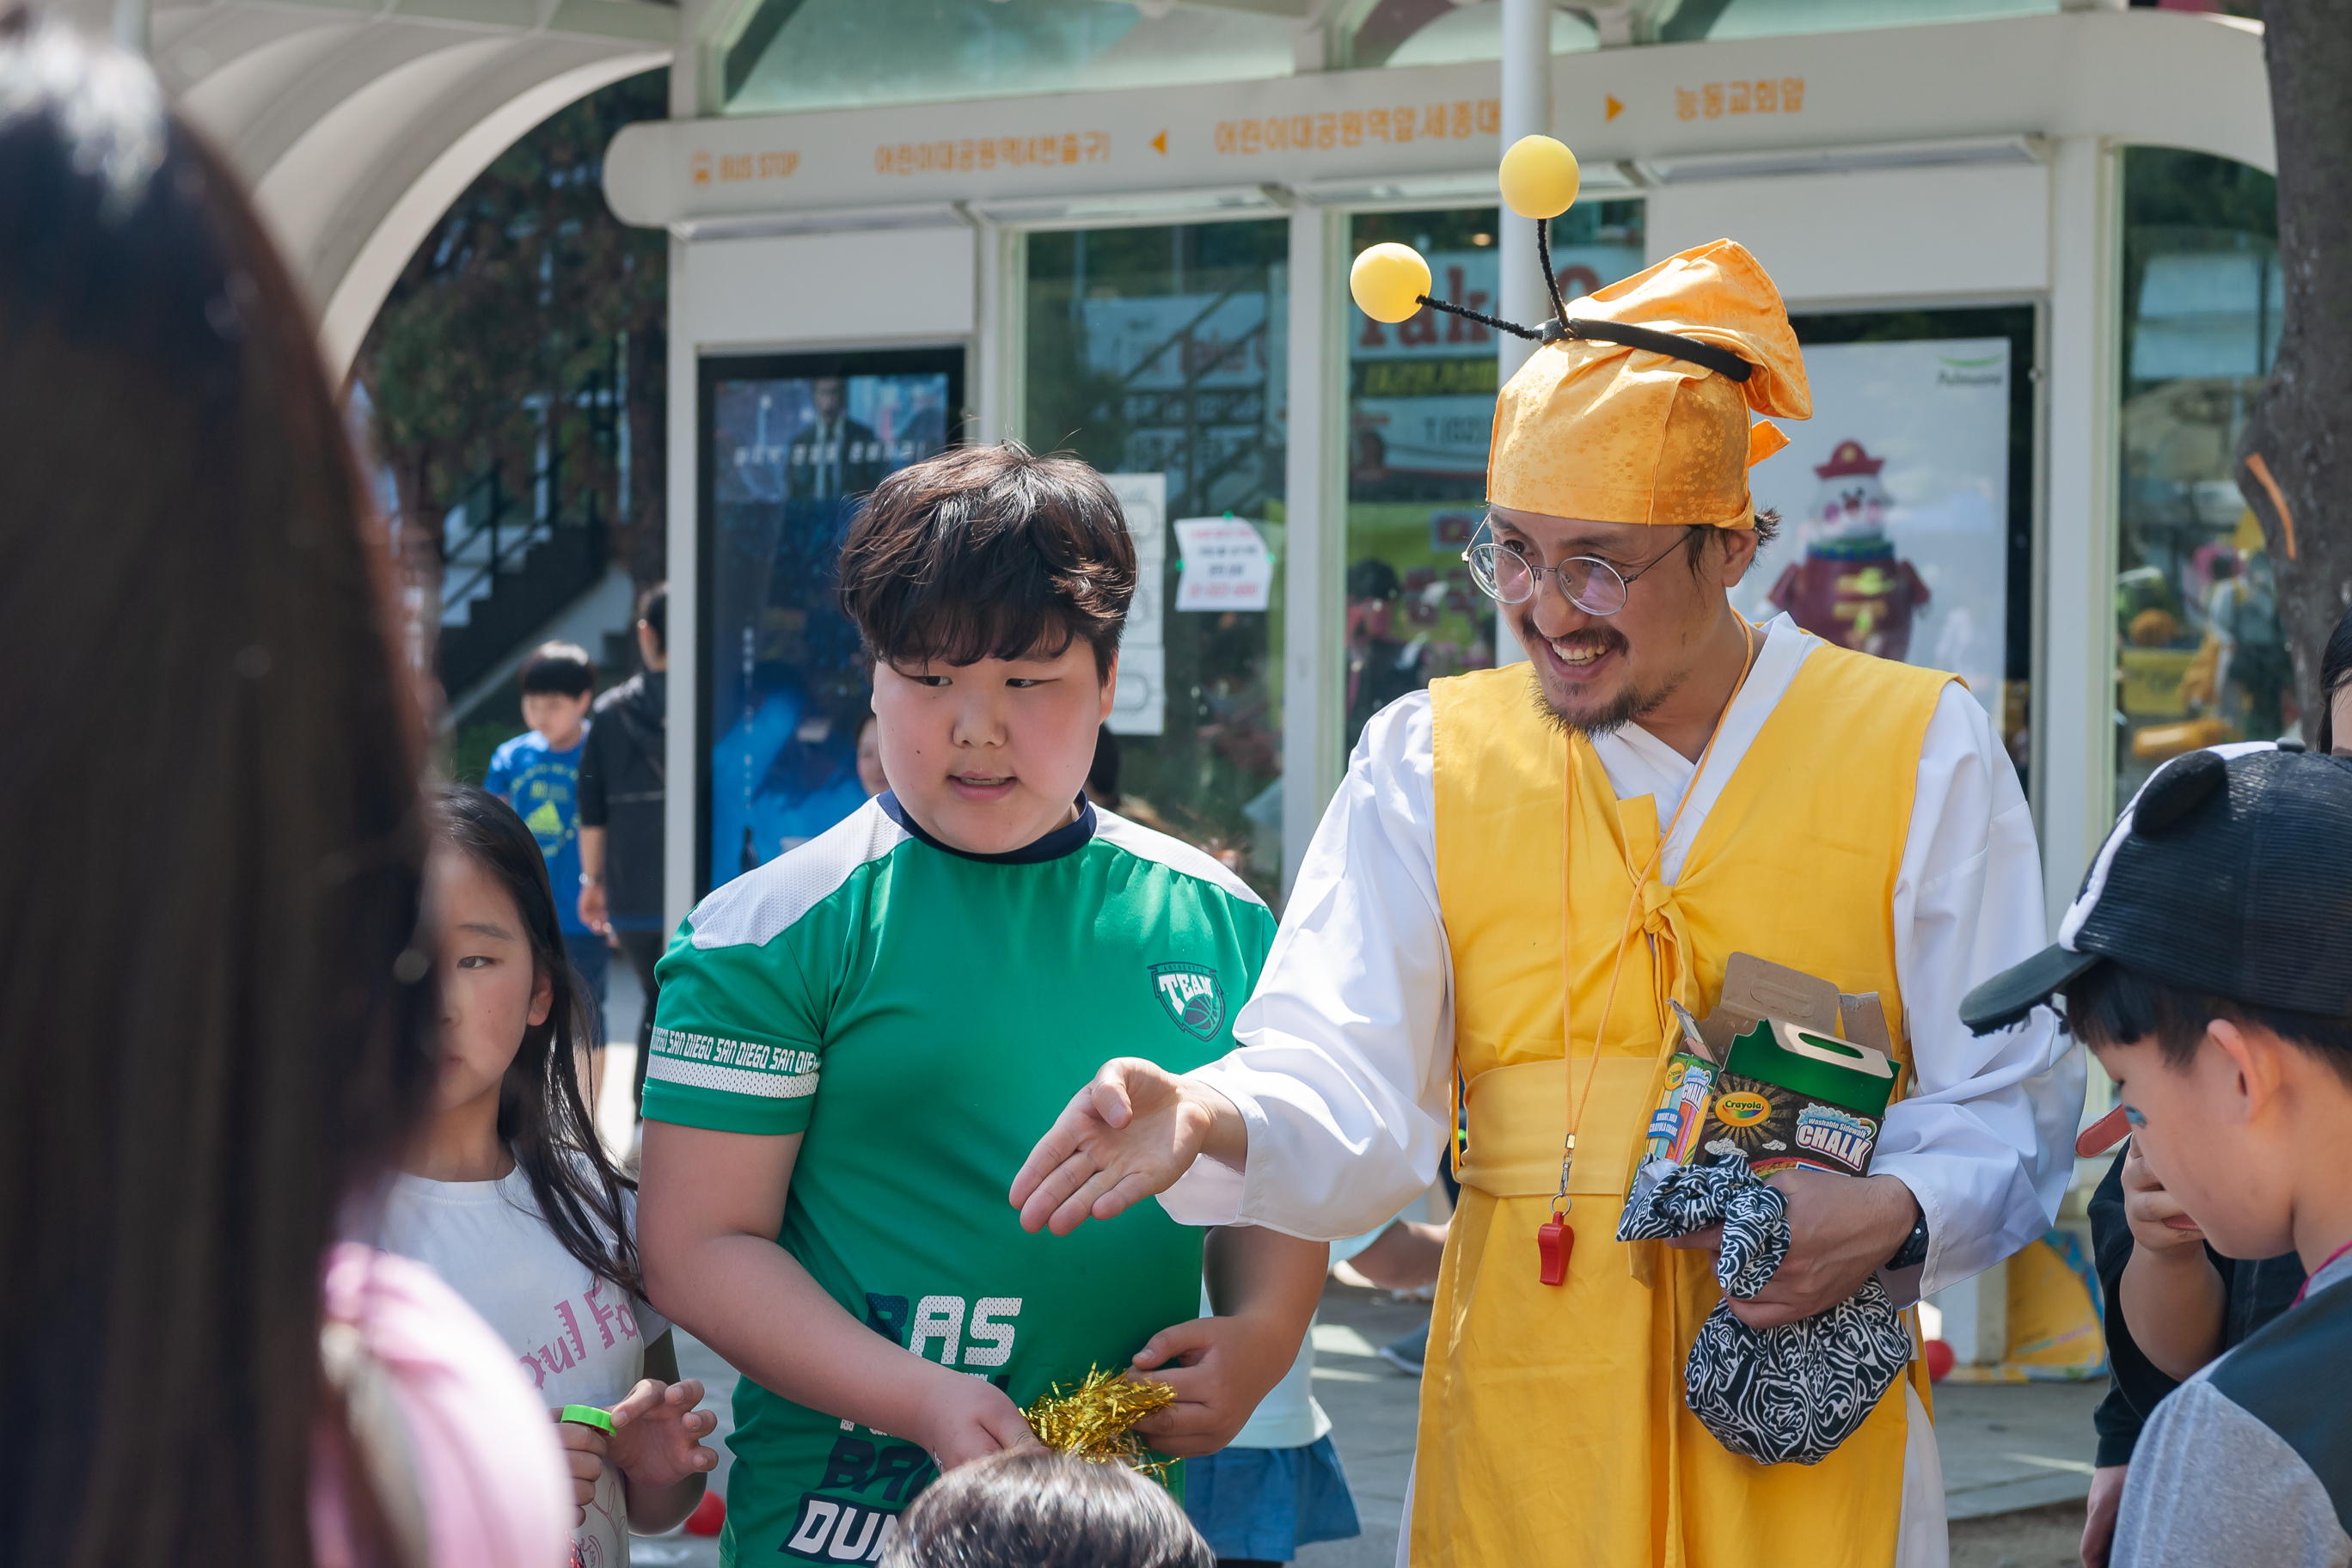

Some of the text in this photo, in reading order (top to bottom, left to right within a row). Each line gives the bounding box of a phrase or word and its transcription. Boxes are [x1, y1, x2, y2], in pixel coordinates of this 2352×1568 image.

[1158, 973, 1214, 1016] TEAM
[667, 1030, 686, 1056] SAN
[683, 1032, 714, 1061] DIEGO
[713, 1038, 738, 1064] SAN
[735, 1041, 770, 1069] DIEGO
[769, 1047, 796, 1073] SAN
[1724, 1099, 1762, 1111] Crayola
[1798, 1125, 1871, 1167] CHALK
[1808, 1118, 1867, 1138] Washable Sidewalk
